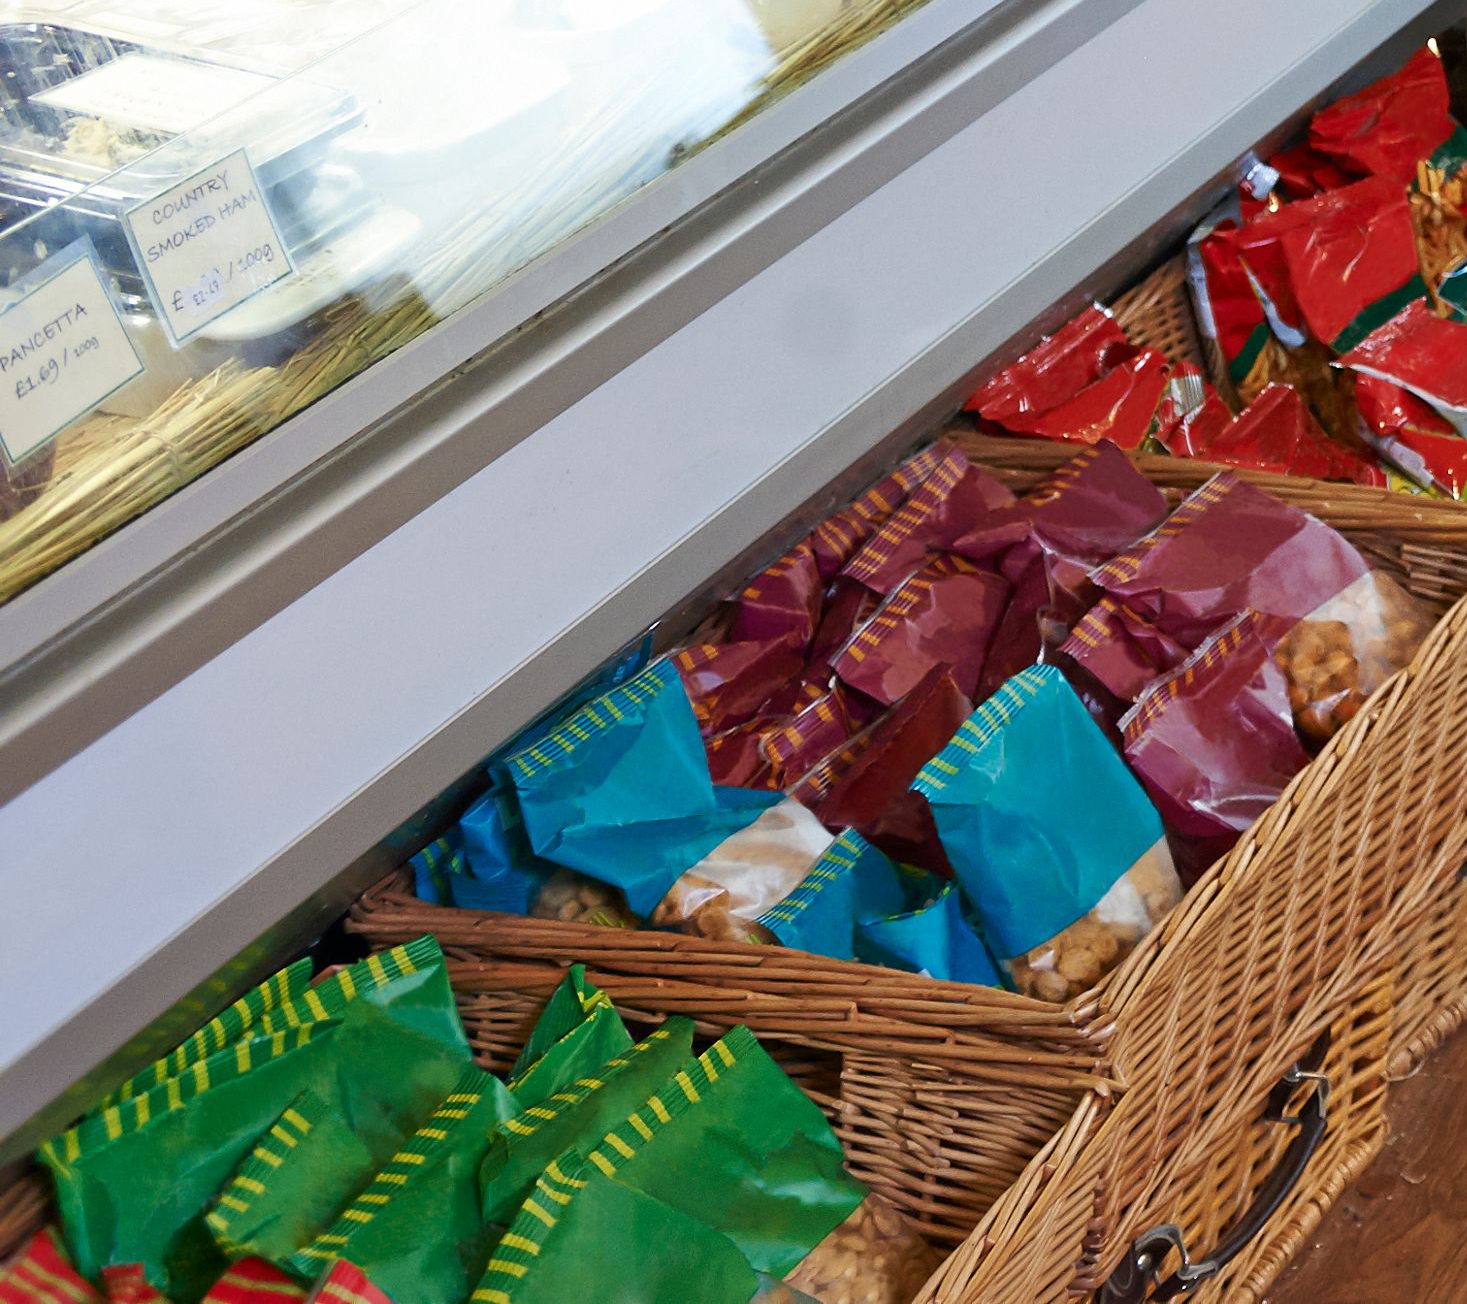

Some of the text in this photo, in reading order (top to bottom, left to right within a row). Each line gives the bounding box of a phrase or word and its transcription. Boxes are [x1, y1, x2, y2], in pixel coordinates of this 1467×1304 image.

[147, 189, 257, 264] SMOKED HAM
[152, 169, 229, 225] COUNTRY
[238, 243, 275, 273] 100g
[0, 302, 88, 373] PANCETTA
[14, 357, 60, 400] £1.69
[72, 336, 100, 359] 100g
